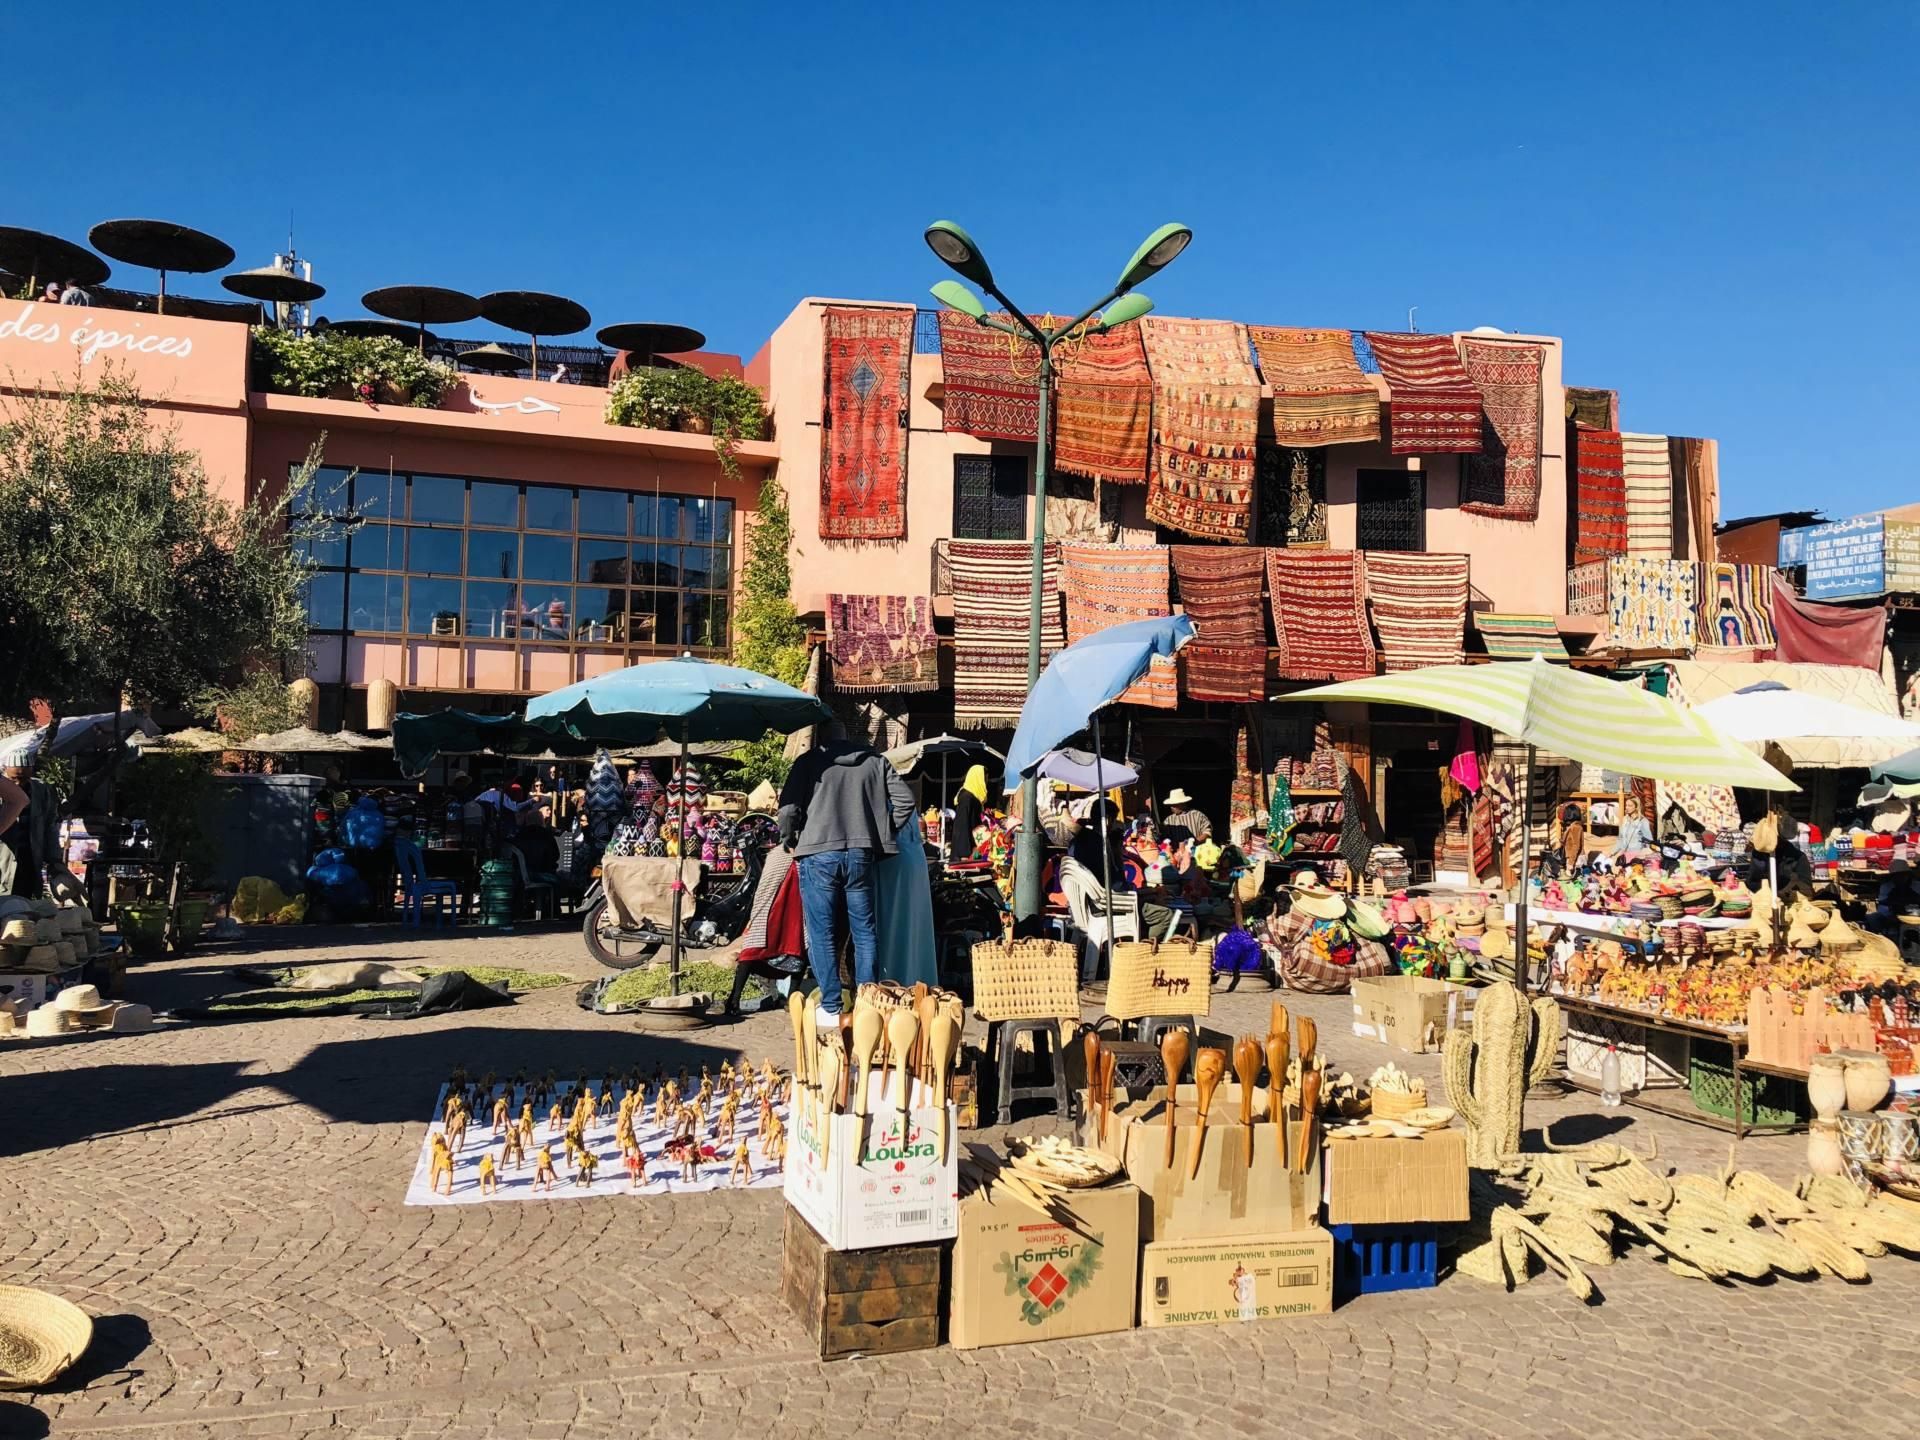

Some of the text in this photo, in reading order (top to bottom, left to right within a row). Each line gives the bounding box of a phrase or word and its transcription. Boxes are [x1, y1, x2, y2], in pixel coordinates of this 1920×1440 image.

[0, 303, 193, 364] des épices
[1807, 542, 1815, 551] LE
[1885, 538, 1895, 549] LE
[1807, 551, 1814, 560] LA
[1815, 549, 1835, 559] VENTE
[1152, 967, 1190, 997] Happy
[865, 1142, 935, 1162] Lousra
[1015, 1243, 1081, 1272] لوسيور
[1167, 1247, 1315, 1264] MINOTERIES TAHANAOUT MARRAKECH
[1164, 1302, 1311, 1323] HENNA SAHARA TAZARINE
